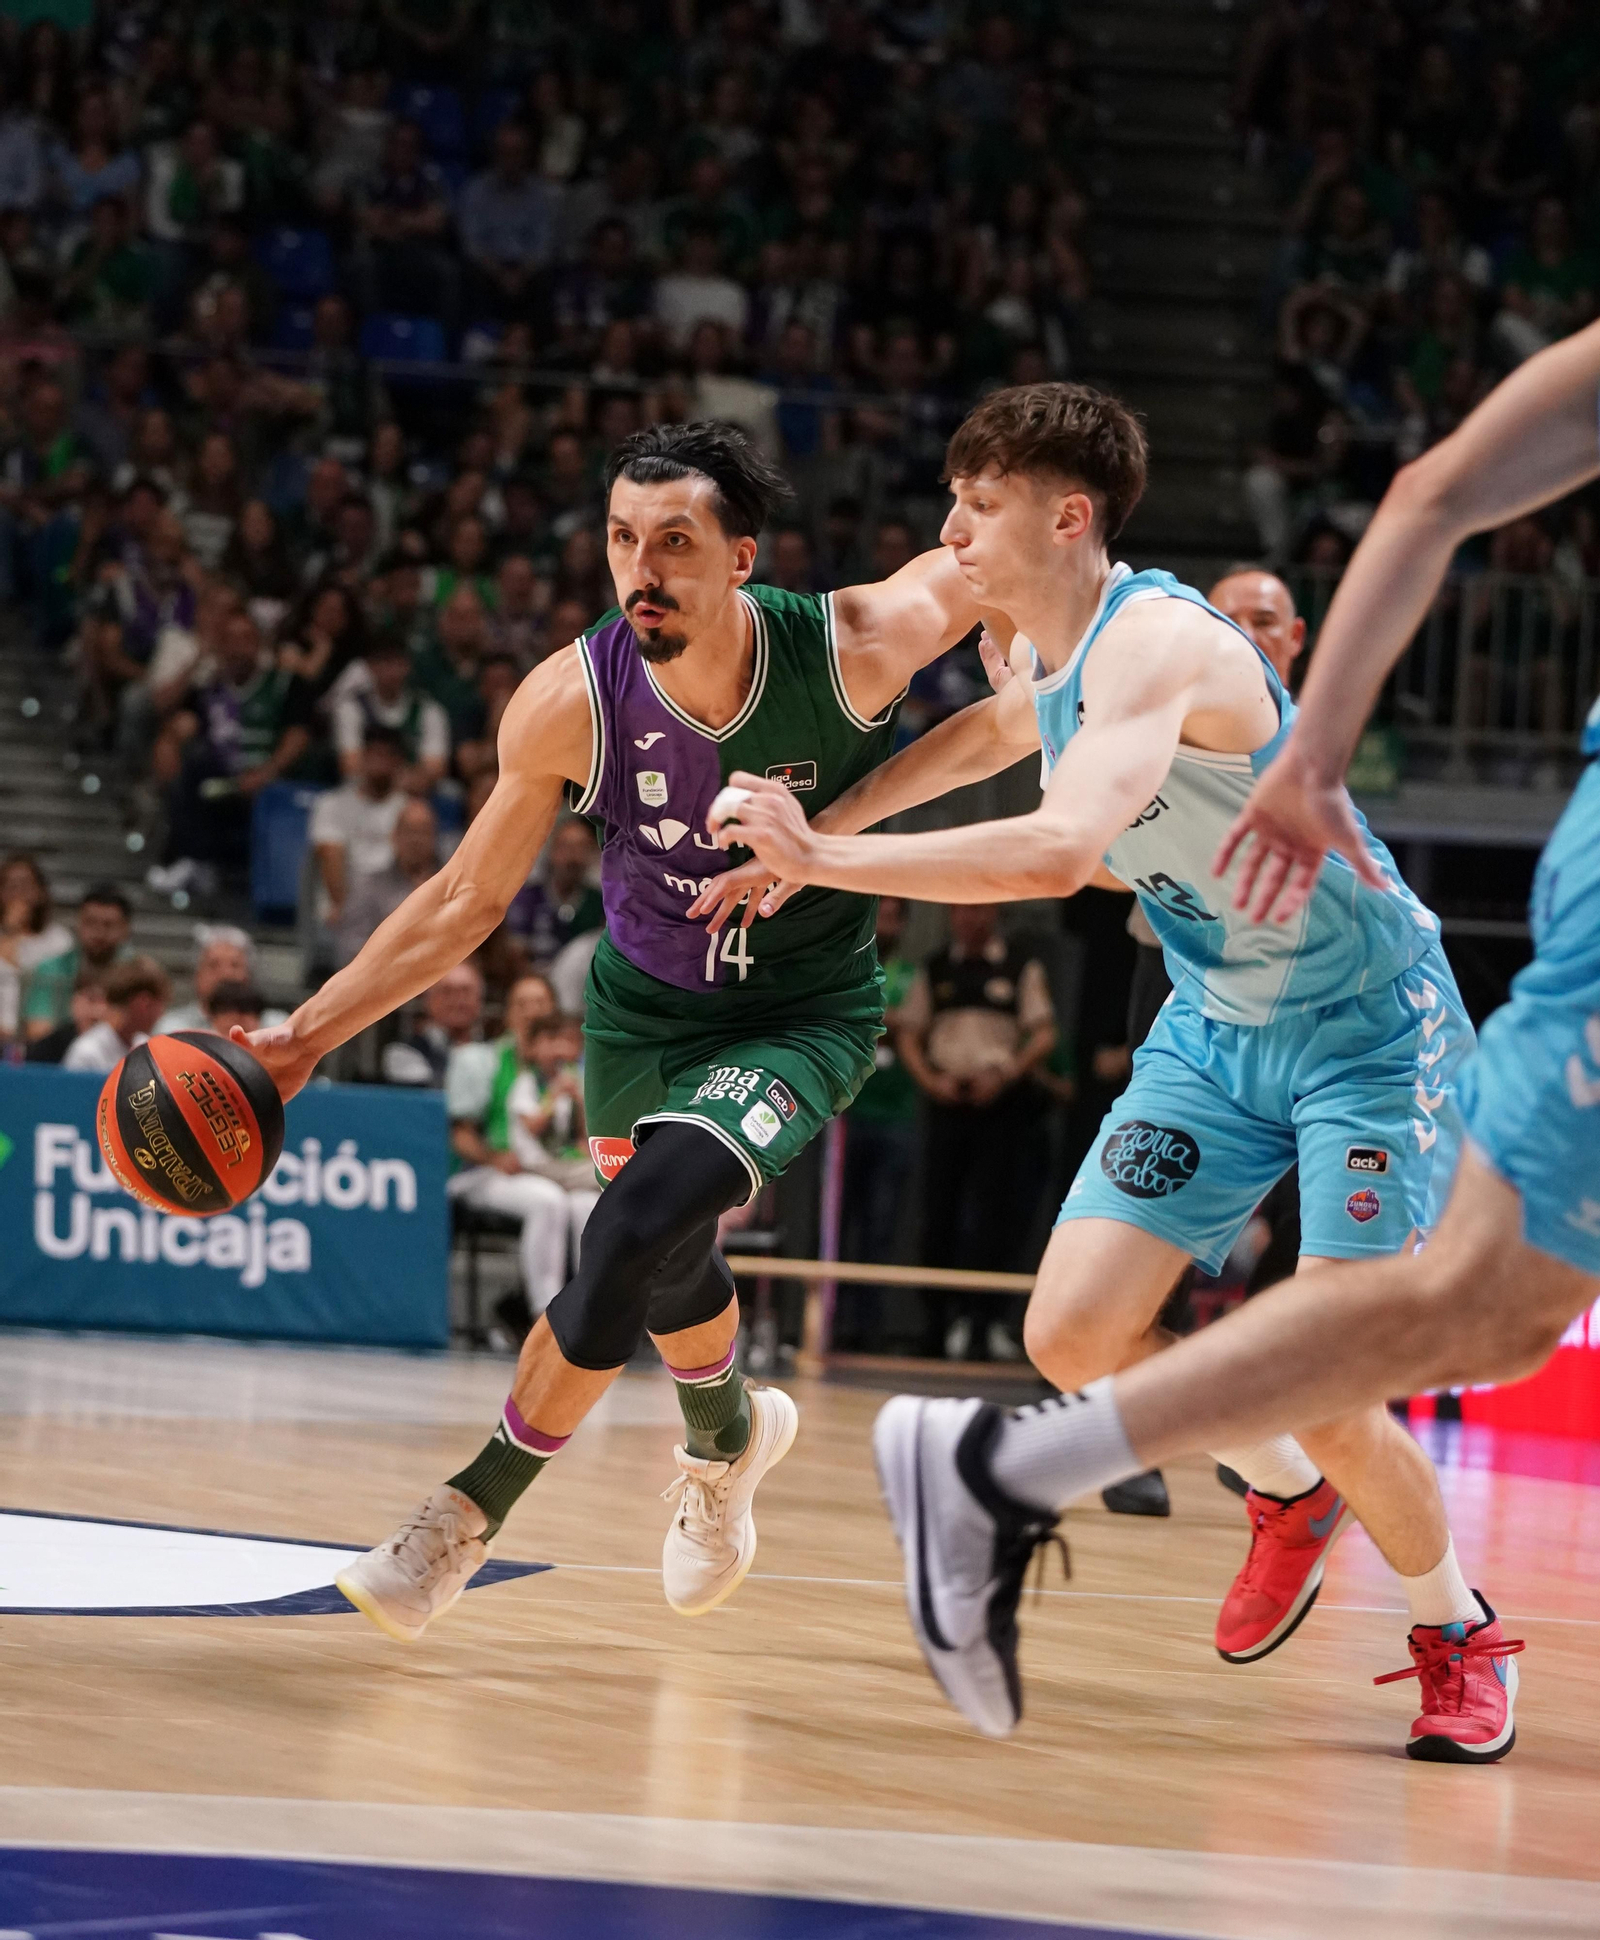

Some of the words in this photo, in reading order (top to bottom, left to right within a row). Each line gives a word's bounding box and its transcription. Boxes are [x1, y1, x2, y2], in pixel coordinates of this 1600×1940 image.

[784, 779, 812, 788] desa
[705, 928, 754, 982] 14
[176, 1070, 245, 1169] LEGACY
[770, 1089, 789, 1112] acb
[128, 1079, 213, 1201] SPALDING
[595, 1140, 632, 1168] fam
[1106, 1146, 1136, 1162] de
[1113, 1124, 1193, 1173] tierra
[1350, 1157, 1379, 1170] acb
[36, 1124, 417, 1211] Fución
[35, 1191, 311, 1288] Unicaja
